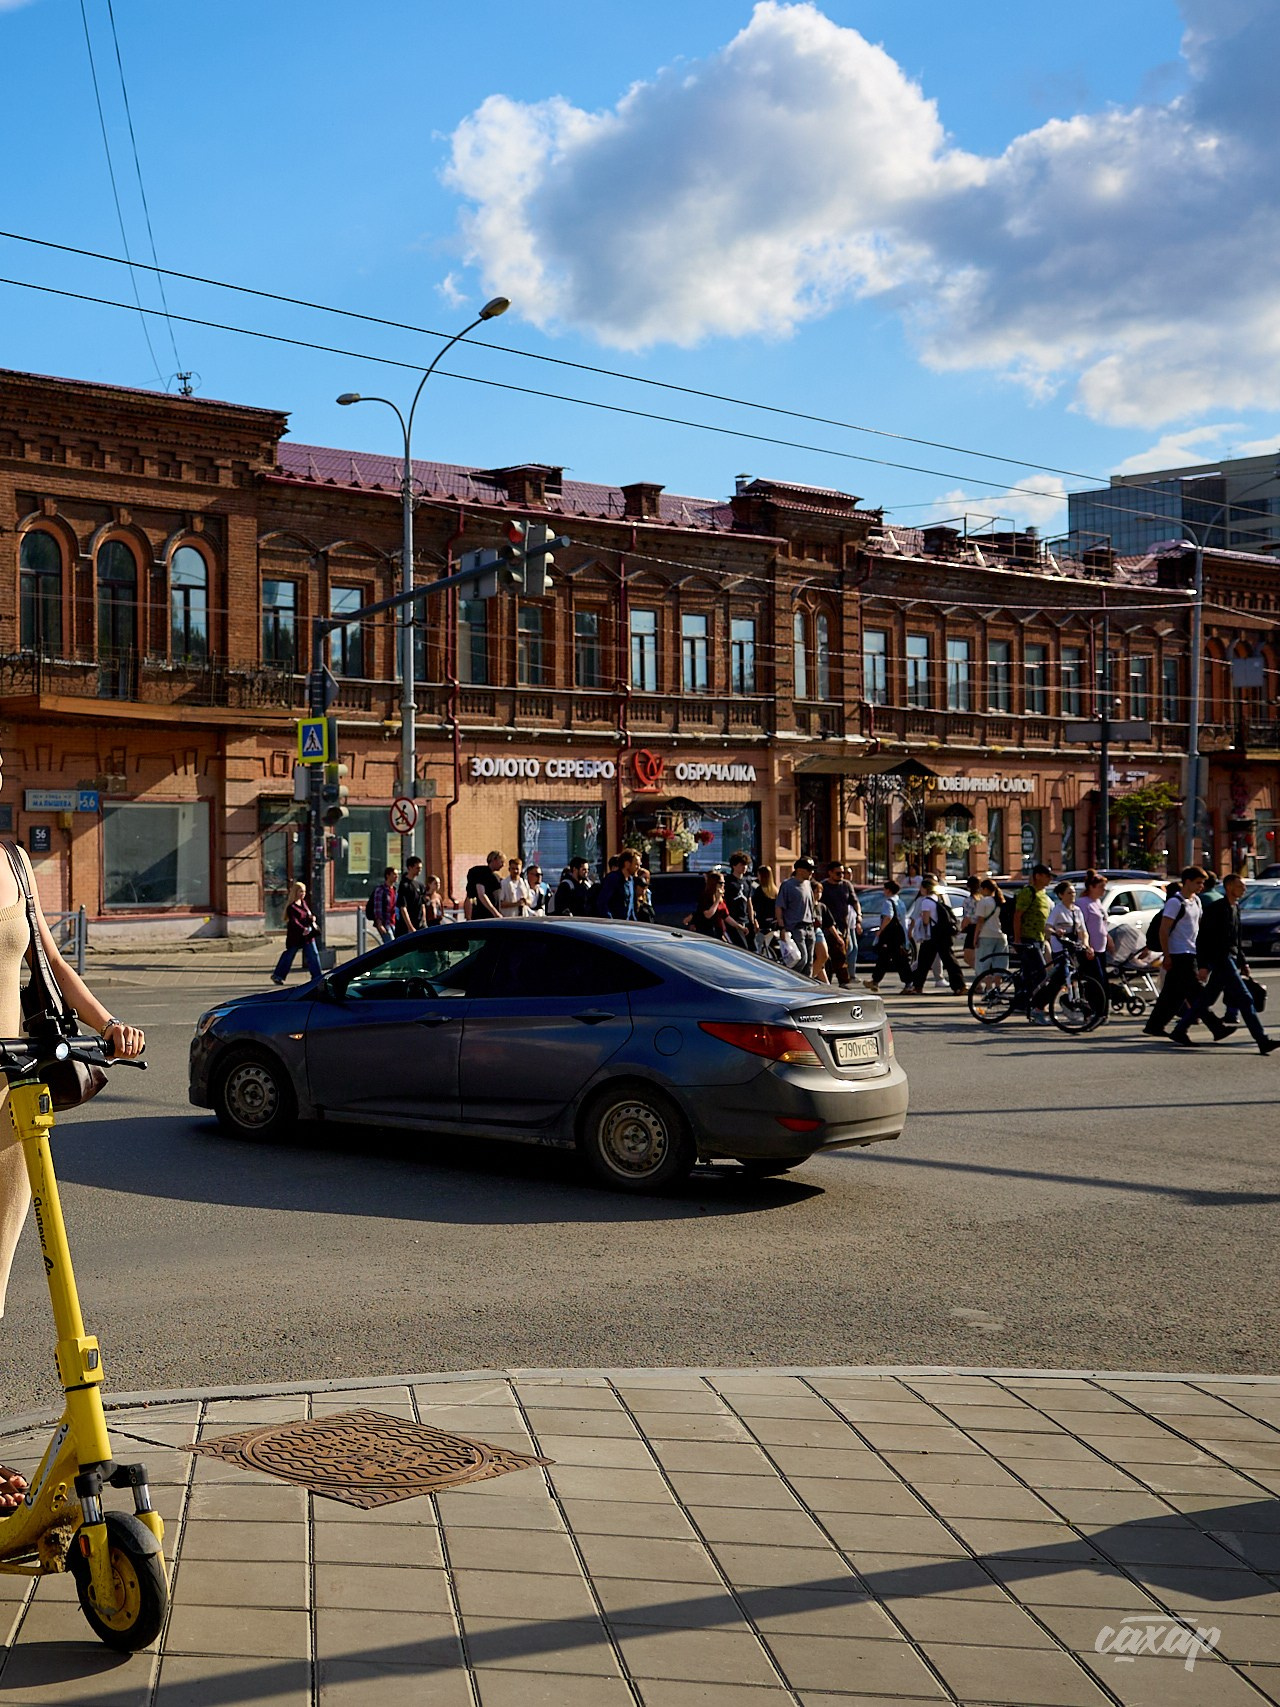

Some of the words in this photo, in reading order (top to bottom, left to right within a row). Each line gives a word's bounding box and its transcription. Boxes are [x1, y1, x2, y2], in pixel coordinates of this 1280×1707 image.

[470, 757, 540, 778] ЗОЛОТО
[545, 759, 615, 780] СЕРЕБРО
[675, 762, 757, 782] ОБРУЧАЛКА
[1001, 778, 1035, 792] САЛОН
[81, 795, 95, 808] 56
[35, 829, 46, 839] 56
